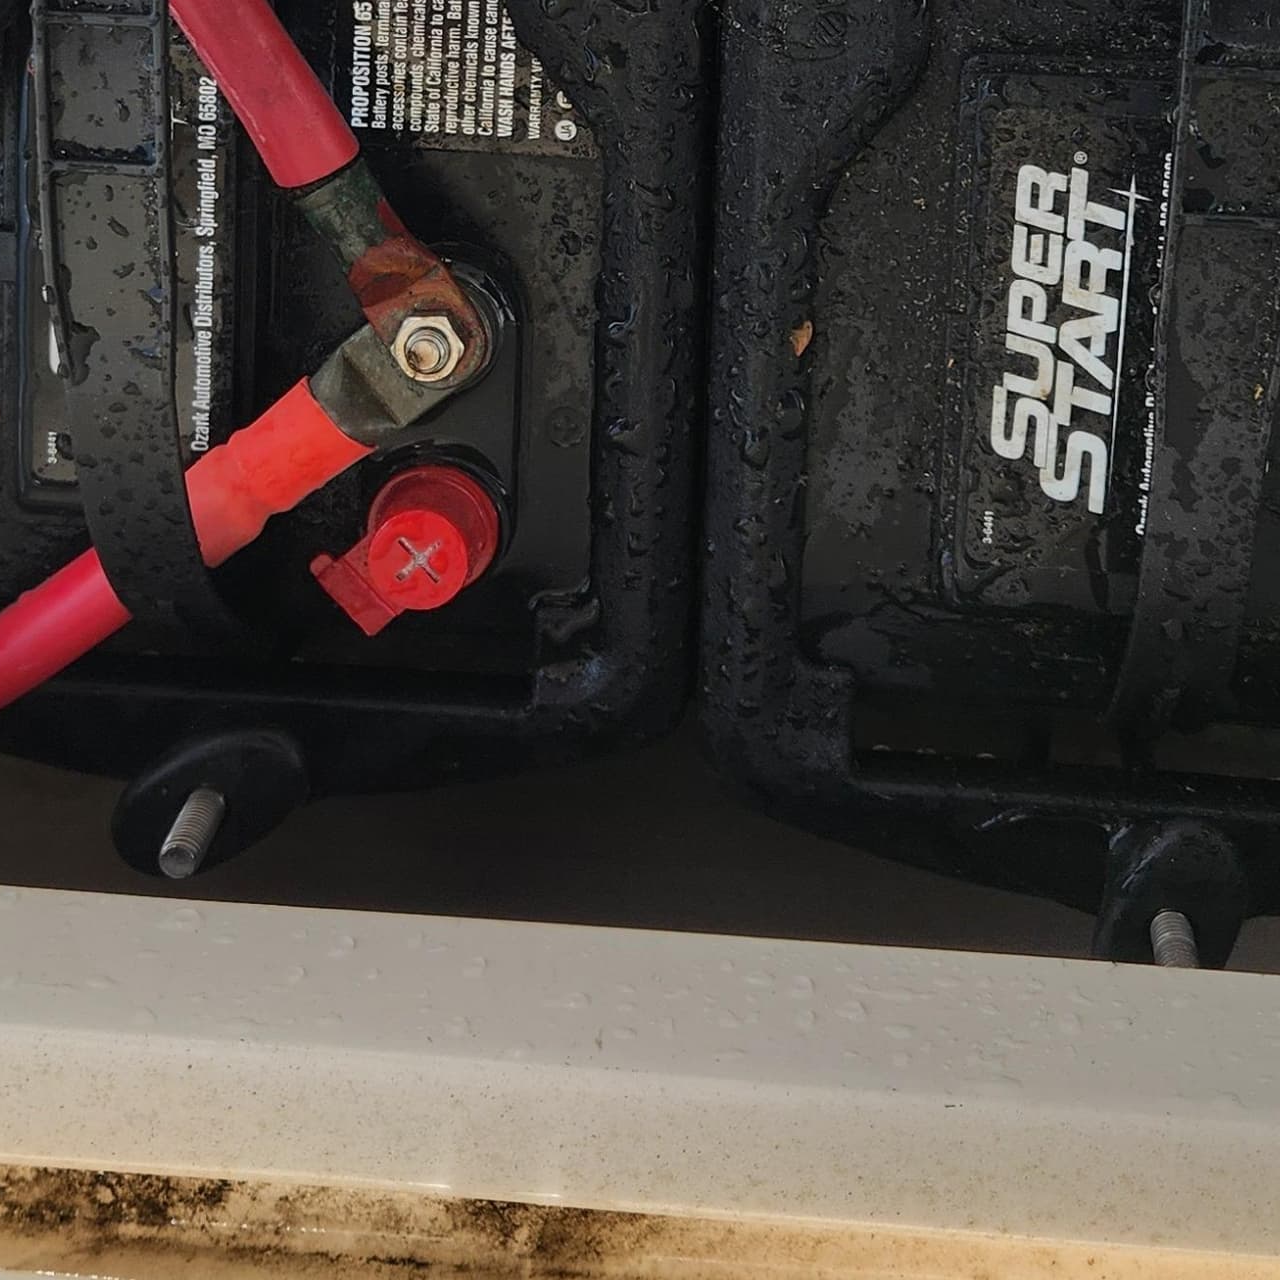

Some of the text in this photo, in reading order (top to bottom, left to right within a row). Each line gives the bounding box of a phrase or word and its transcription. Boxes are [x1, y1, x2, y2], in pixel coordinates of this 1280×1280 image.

[350, 25, 371, 127] PROPOSITION
[353, 1, 372, 20] 65
[190, 76, 219, 451] Ozark Automotive Distributors, Springfield, MO 65802
[989, 165, 1069, 468] SUPER
